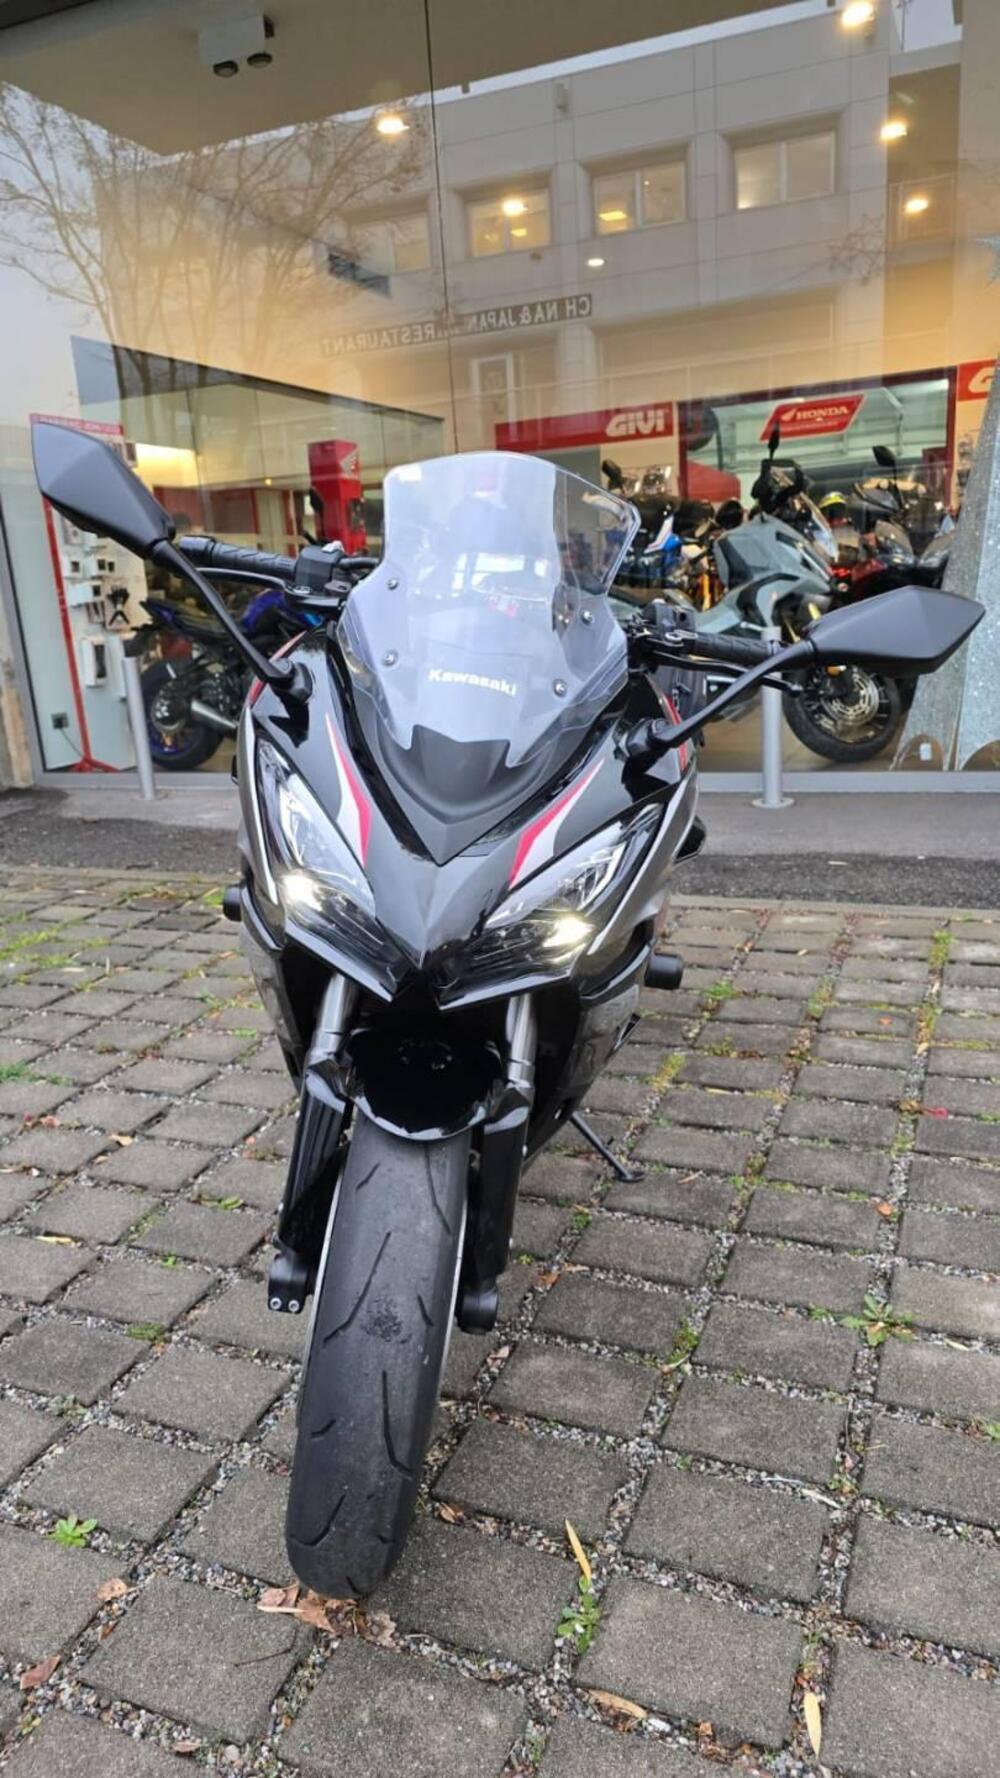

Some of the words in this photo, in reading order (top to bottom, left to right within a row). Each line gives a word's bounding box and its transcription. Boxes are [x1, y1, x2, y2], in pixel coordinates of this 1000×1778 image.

[605, 409, 665, 437] GIVI
[796, 406, 849, 420] HONDA
[428, 668, 517, 697] Kawasaki
